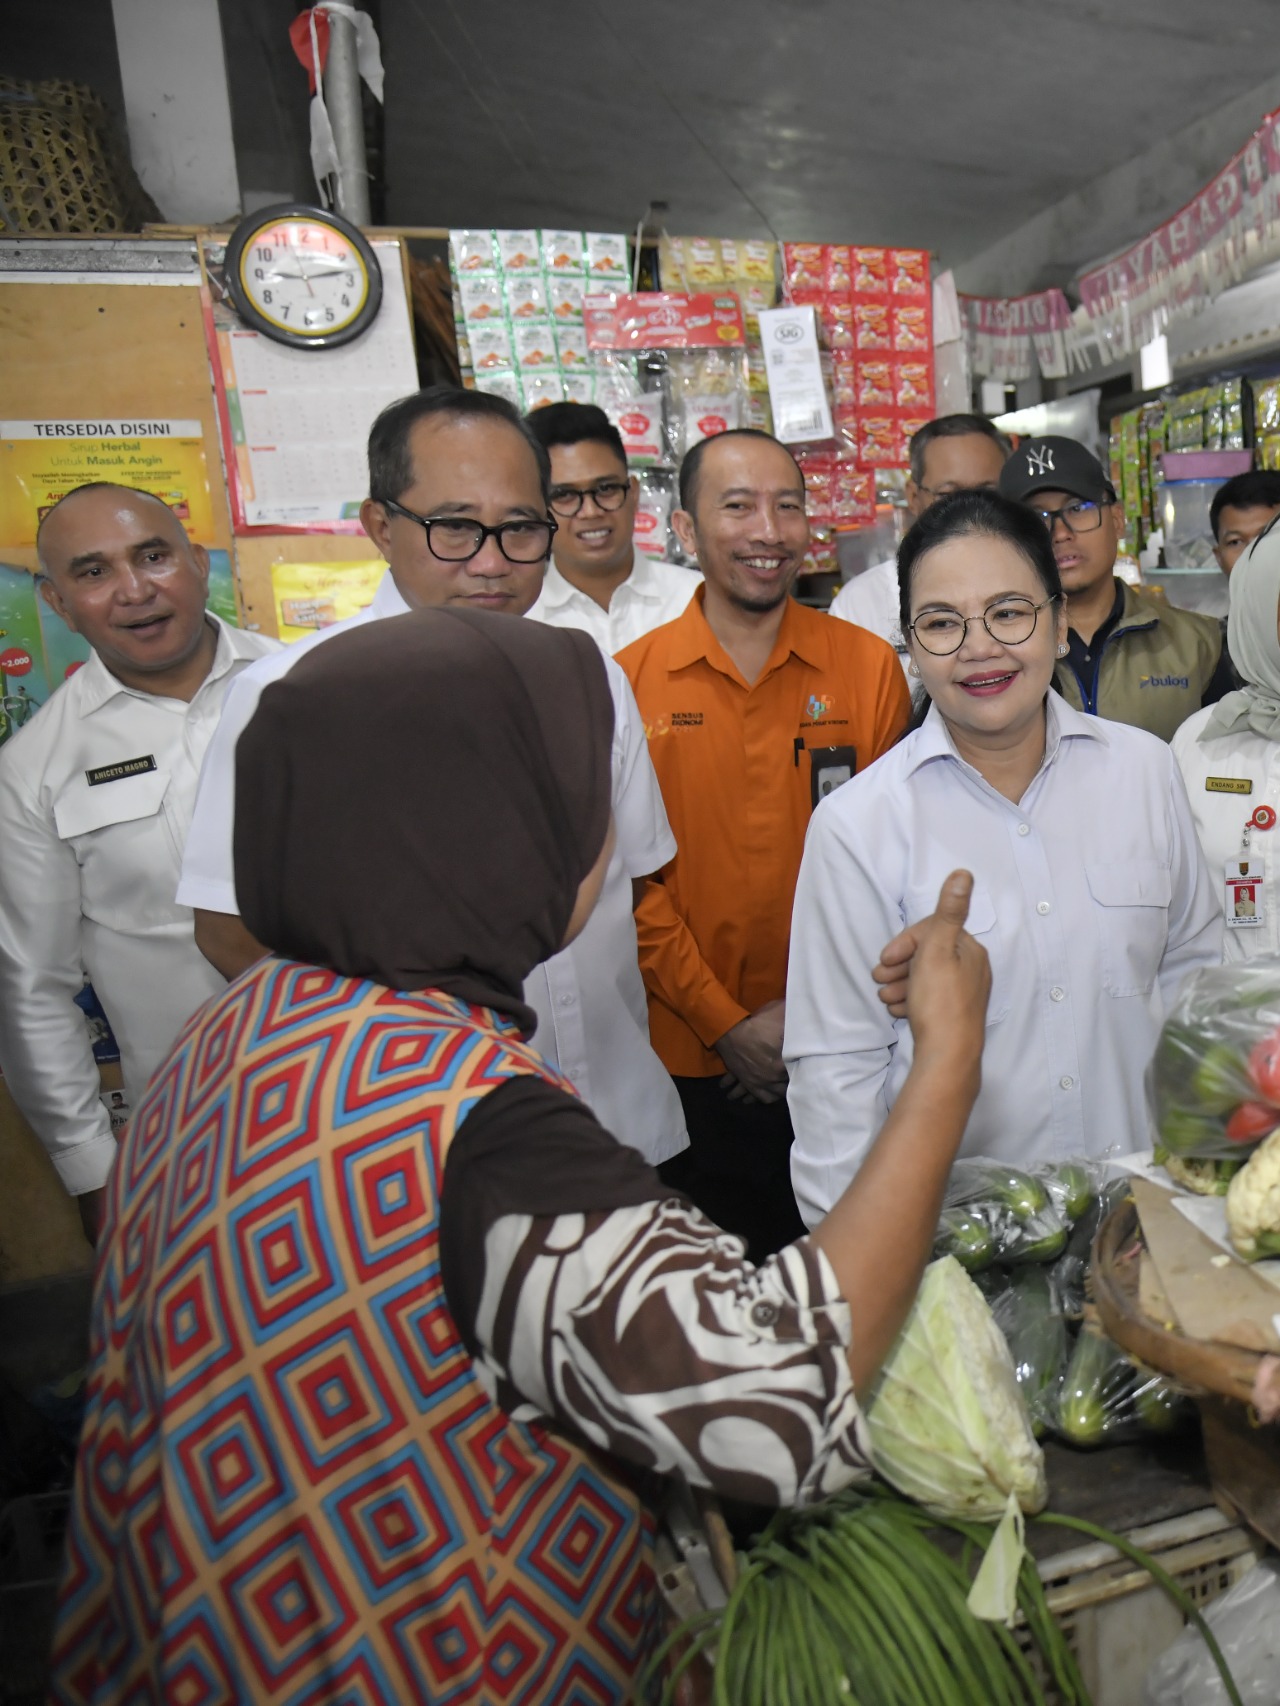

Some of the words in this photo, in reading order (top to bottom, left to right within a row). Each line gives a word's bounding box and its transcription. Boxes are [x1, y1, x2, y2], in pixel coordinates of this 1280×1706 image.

[256, 248, 273, 262] 10
[345, 273, 355, 288] 3
[263, 290, 273, 304] 8
[341, 294, 351, 308] 4
[280, 306, 290, 319] 7
[325, 308, 335, 322] 5
[34, 424, 116, 437] TERSEDIA
[120, 423, 171, 436] DISINI
[101, 441, 141, 452] Herbal
[50, 456, 83, 467] Untuk
[86, 456, 125, 466] Masuk
[128, 454, 163, 467] Angin
[1150, 674, 1189, 689] bulog
[94, 767, 124, 781] ANICETO
[124, 760, 149, 772] MAGNO
[1211, 781, 1234, 789] ENDANG
